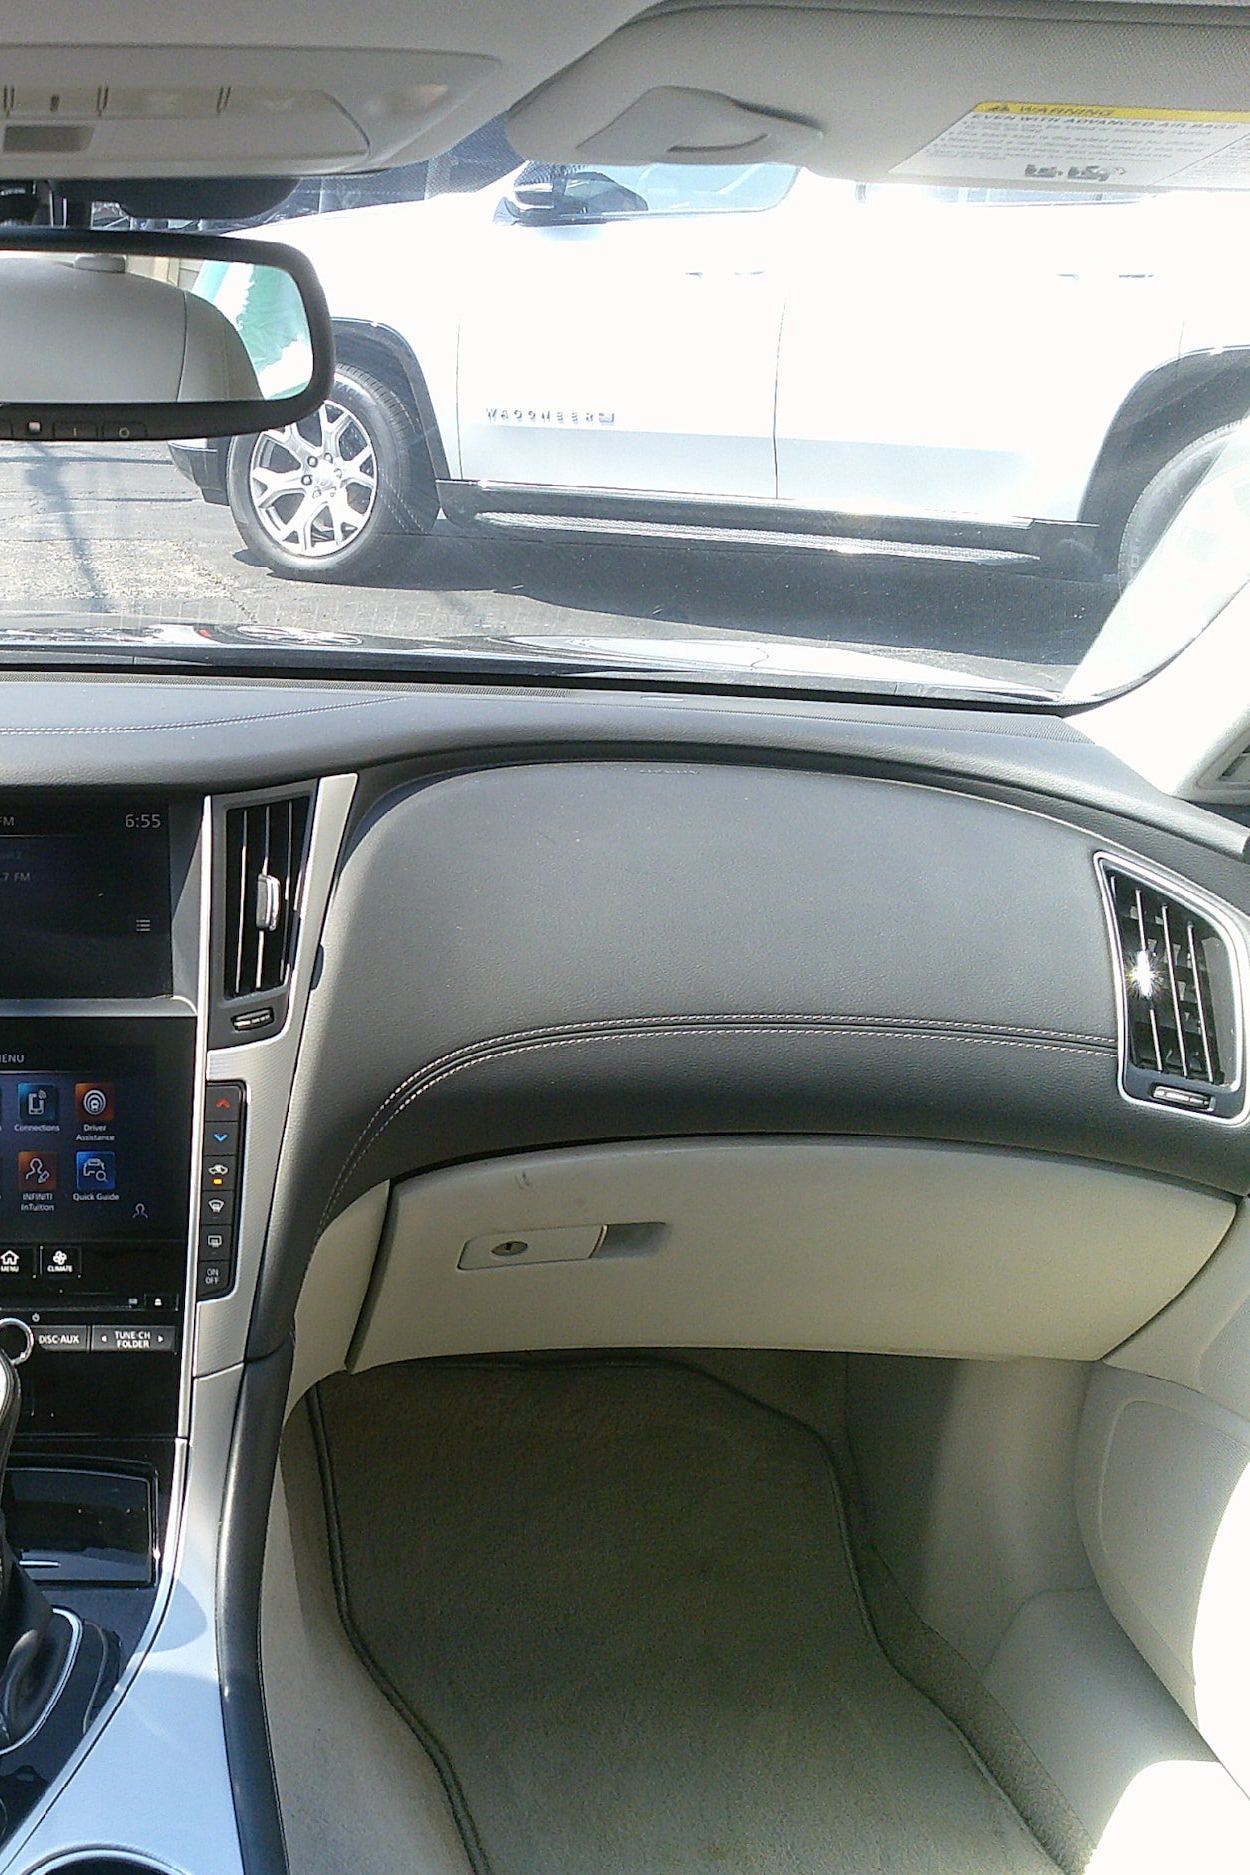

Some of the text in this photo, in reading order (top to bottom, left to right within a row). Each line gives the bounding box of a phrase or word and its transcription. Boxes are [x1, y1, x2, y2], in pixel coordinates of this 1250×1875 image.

[1018, 104, 1115, 117] WARNING
[125, 813, 162, 829] 6:55
[13, 871, 31, 882] FM
[13, 1123, 61, 1133] Connections
[83, 1123, 108, 1133] Driver
[75, 1133, 116, 1142] Assistance
[22, 1192, 53, 1202] INFINITI
[72, 1192, 120, 1203] Quick Guide
[0, 1265, 20, 1274] MENU
[46, 1264, 74, 1274] CLIMATE
[206, 1267, 220, 1277] ON
[204, 1275, 220, 1285] OFF
[117, 1340, 150, 1350] FOLDER
